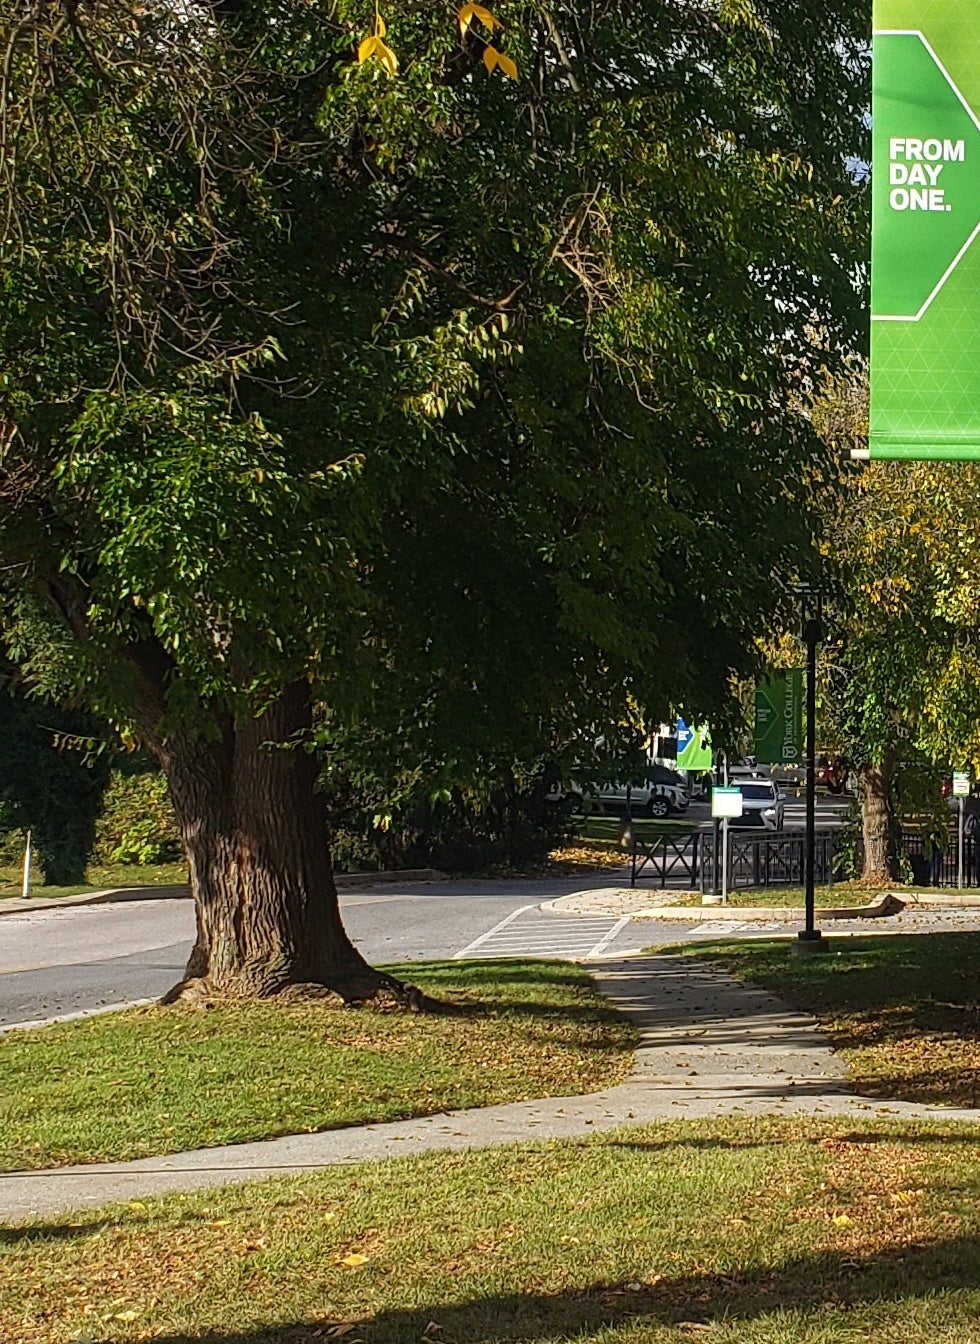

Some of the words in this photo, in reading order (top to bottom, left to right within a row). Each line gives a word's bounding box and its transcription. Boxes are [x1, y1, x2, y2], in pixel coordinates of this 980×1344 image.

[889, 137, 965, 163] FROM
[889, 164, 943, 186] DAY
[889, 188, 952, 212] ONE.
